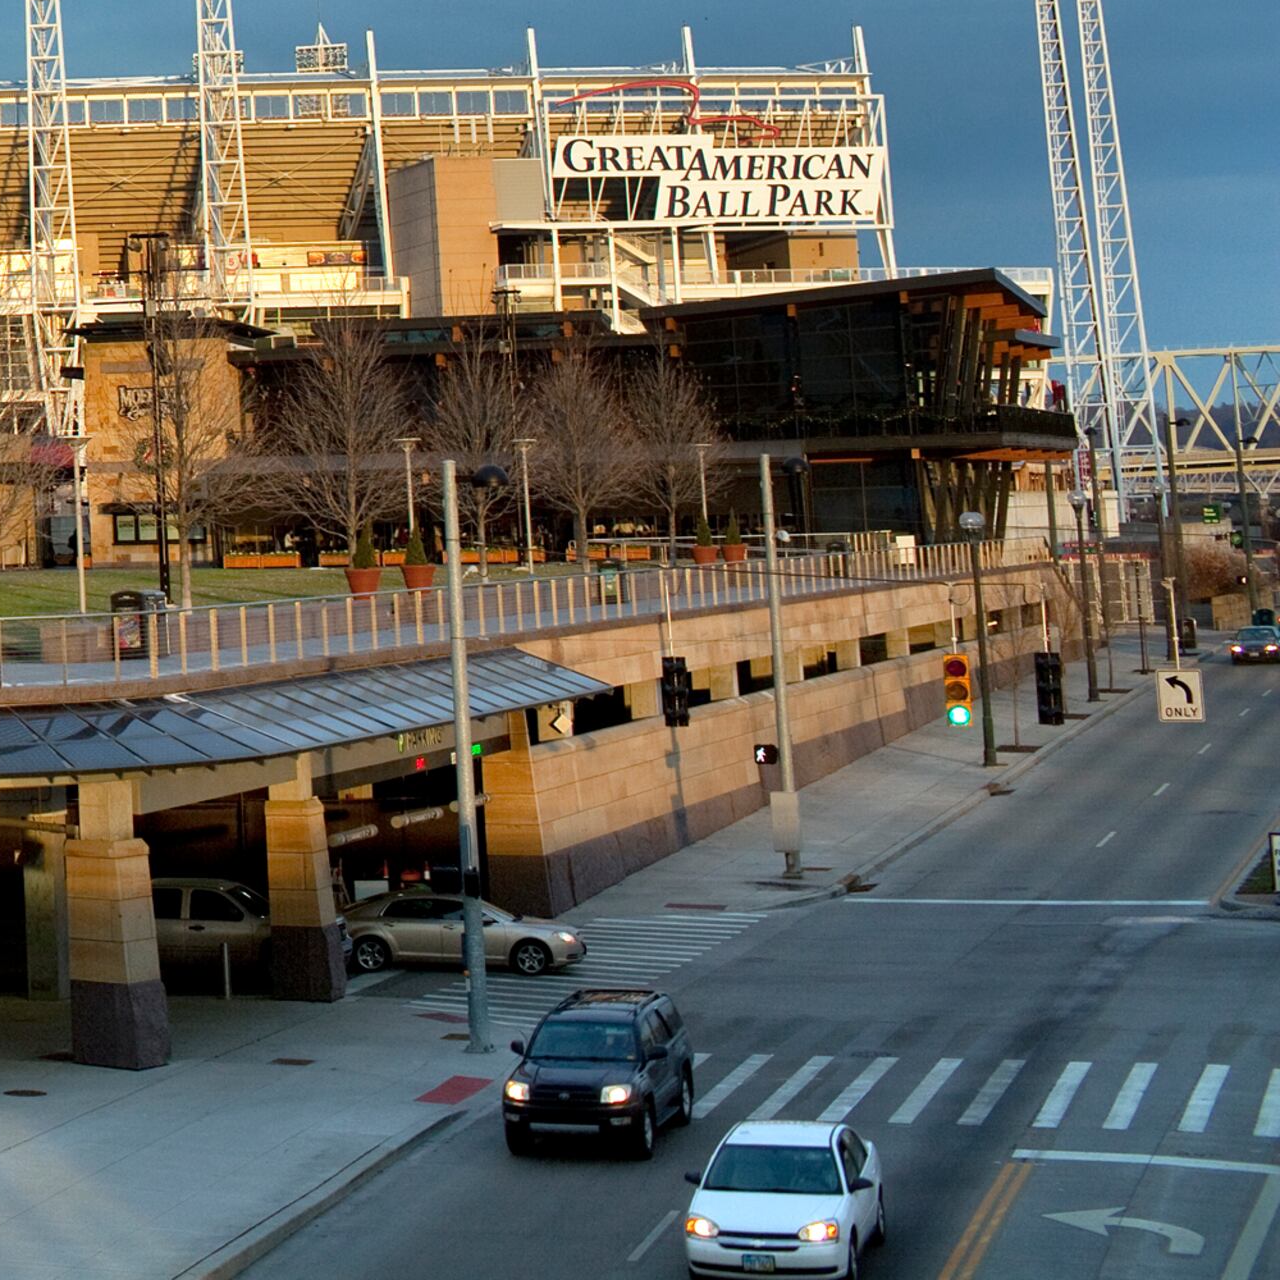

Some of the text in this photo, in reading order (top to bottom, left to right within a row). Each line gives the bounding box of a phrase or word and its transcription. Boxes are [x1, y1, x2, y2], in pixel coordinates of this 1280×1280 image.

[562, 138, 875, 182] GREAT AMERICAN
[664, 184, 769, 219] BALL
[767, 184, 867, 217] PARK
[1165, 707, 1198, 717] ONLY
